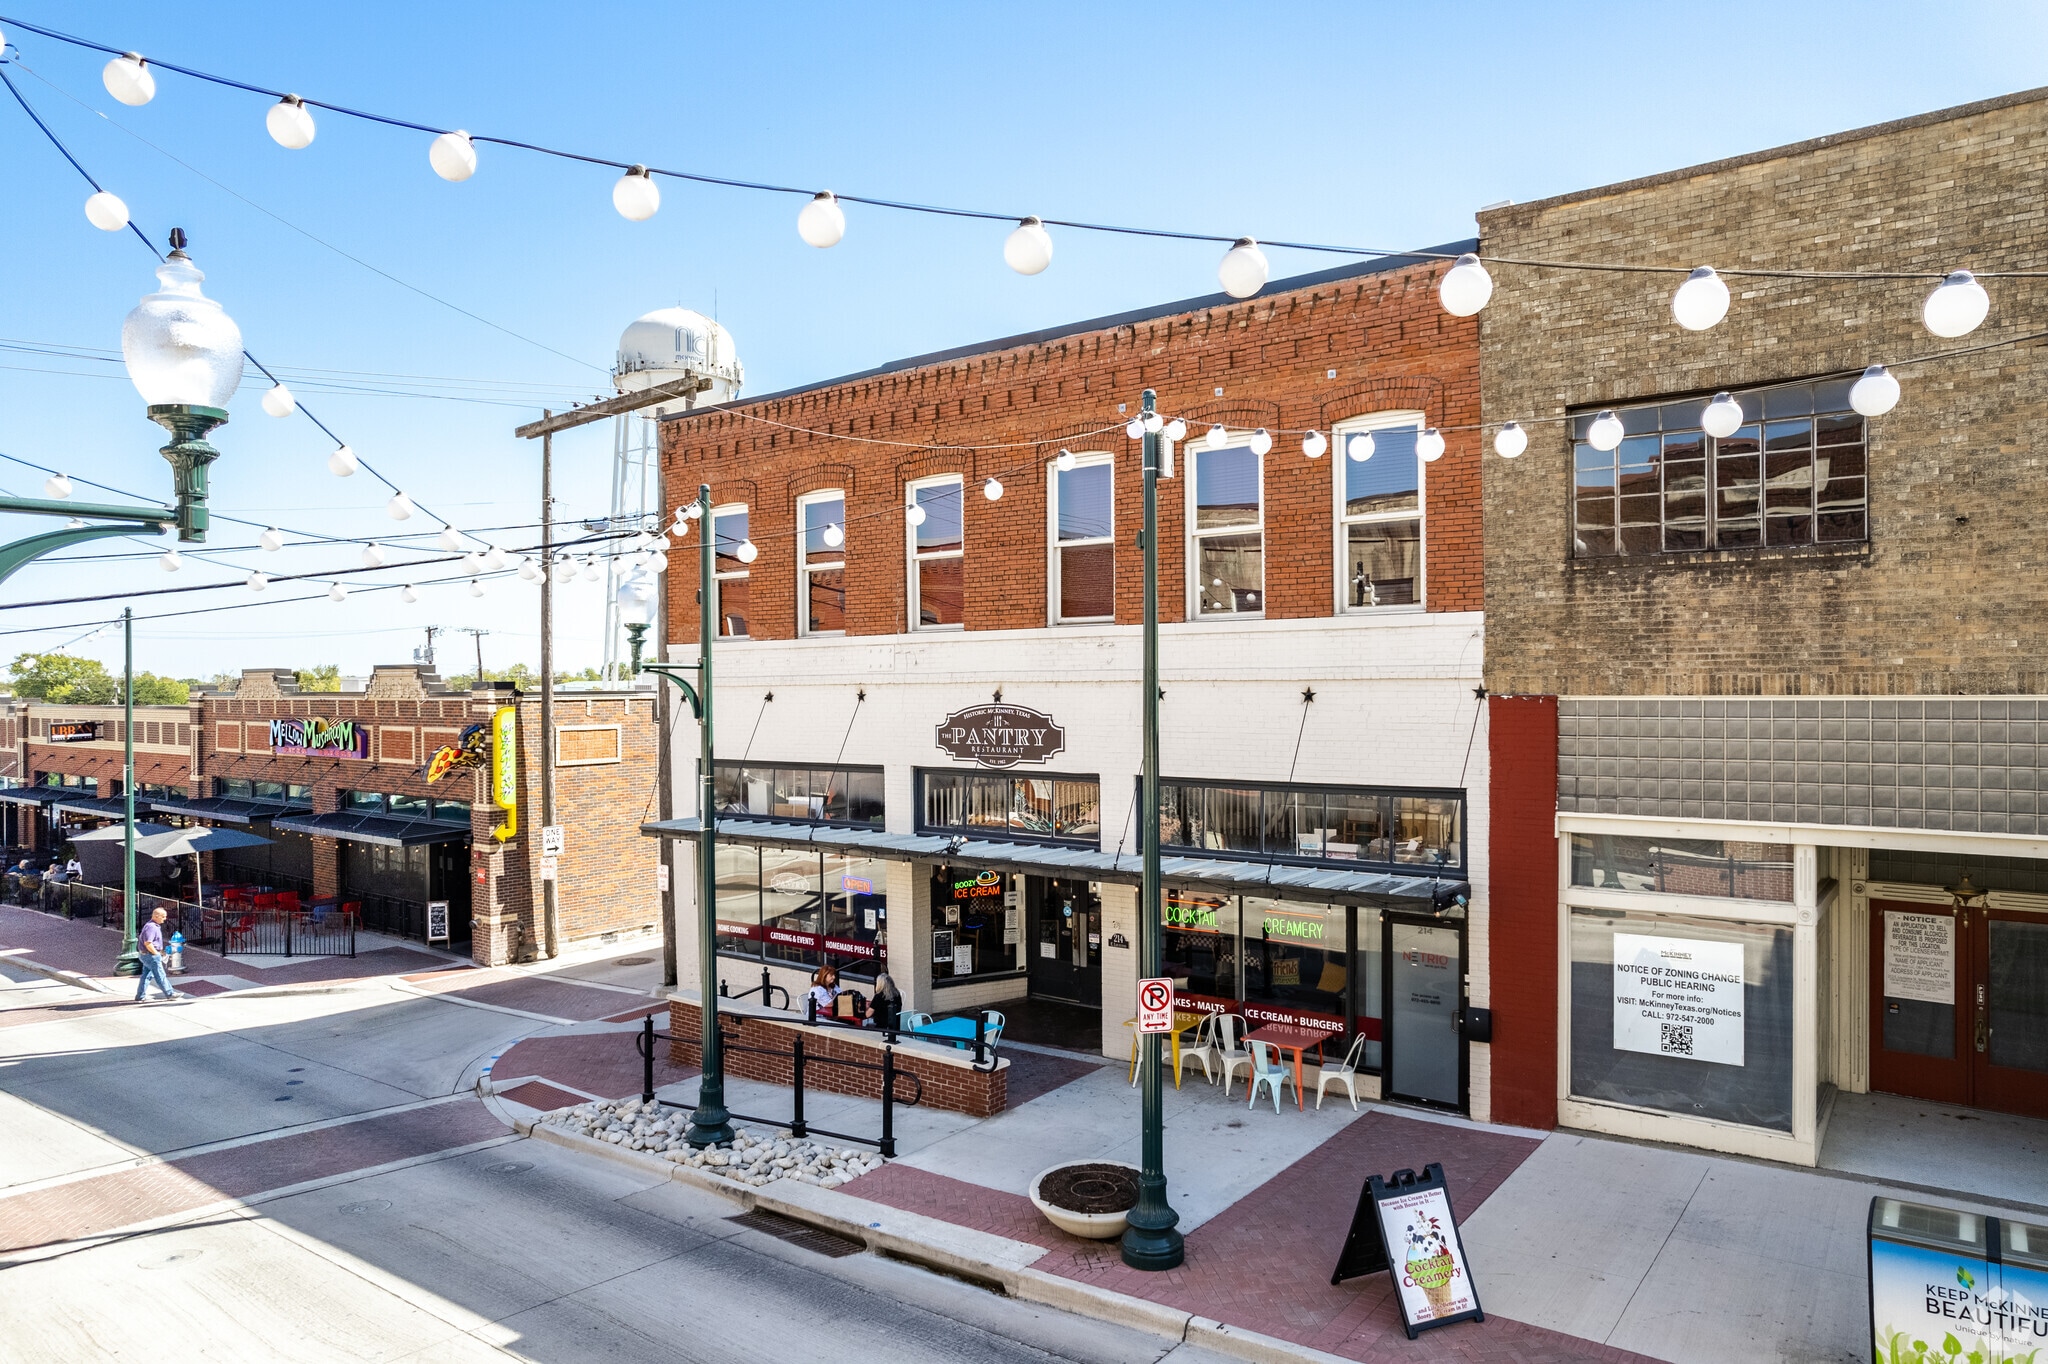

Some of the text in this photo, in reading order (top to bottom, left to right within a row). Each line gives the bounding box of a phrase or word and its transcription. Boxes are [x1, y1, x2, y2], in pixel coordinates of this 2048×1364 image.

[963, 709, 987, 720] HISTORIC
[1015, 709, 1031, 719] TEXAS
[269, 719, 354, 751] MELLOW MUSHROOM
[951, 727, 1048, 746] PANTRY
[971, 746, 1024, 754] RESTAURANT
[843, 877, 870, 893] OPEN
[954, 880, 976, 889] BOOZY
[954, 885, 1000, 898] ICE CREAM
[1165, 906, 1219, 928] COCKTAIL
[1903, 916, 1937, 924] NOTICE
[717, 924, 749, 935] HOME COOKING
[1264, 917, 1323, 939] CREAMERY
[1417, 927, 1433, 935] 214
[1901, 922, 1927, 930] APPLICATION
[770, 931, 792, 942] CATERING
[796, 936, 814, 946] EVENTS
[1114, 935, 1124, 943] 214
[825, 940, 887, 958] HOMEMADE PIES & CES
[1402, 951, 1449, 966] NETRIO
[1273, 961, 1297, 975] friends
[1617, 964, 1740, 984] NOTICE OF ZONING CHANGE
[1640, 977, 1715, 993] PUBLIC HEARING
[1651, 990, 1704, 1003] For more info:
[1197, 1001, 1225, 1013] MALTS
[1617, 996, 1742, 1018] VISIT: McKinneyTexas.org/Notices
[1156, 1012, 1169, 1020] TIME
[1245, 1008, 1344, 1032] ICE CREAM BURGERS
[1641, 1010, 1715, 1025] CALL: 972-547-2000
[1404, 1254, 1455, 1275] Cocktail
[1403, 1267, 1461, 1288] Creamery
[1926, 1283, 1969, 1302] KEEP
[1954, 1324, 2035, 1347] Unique by nature.
